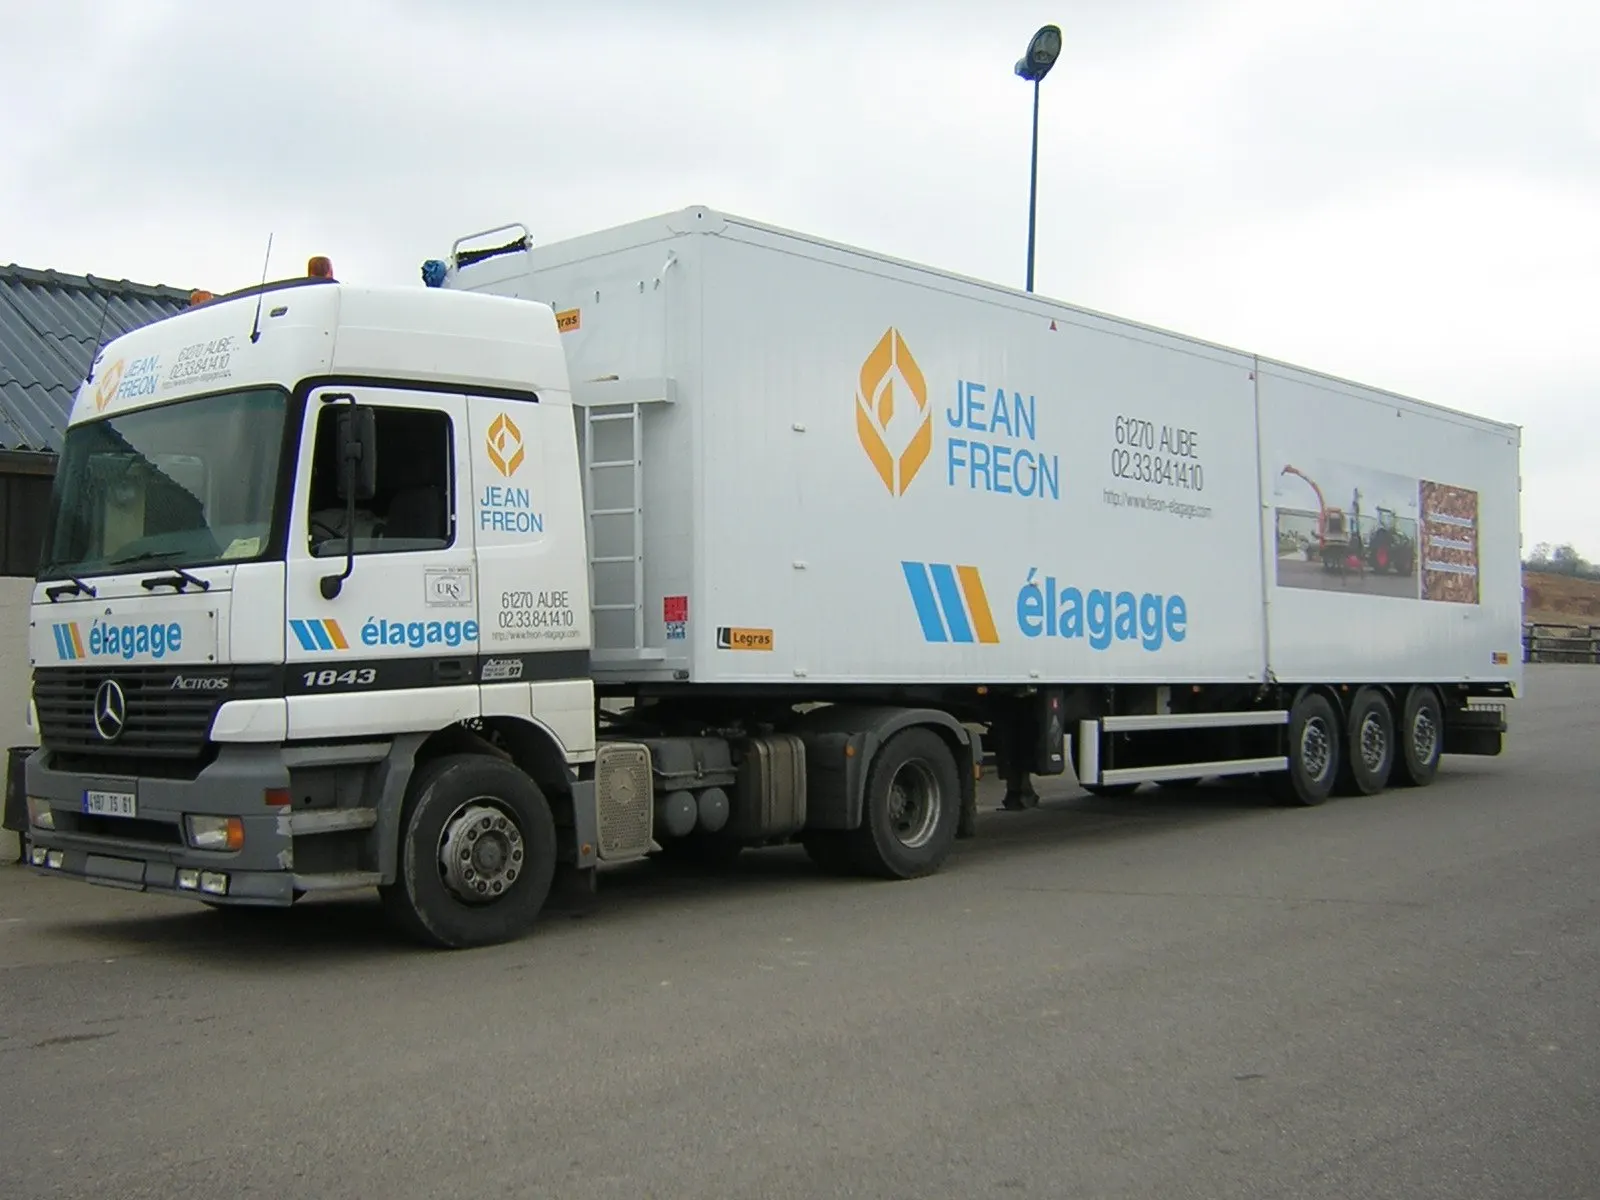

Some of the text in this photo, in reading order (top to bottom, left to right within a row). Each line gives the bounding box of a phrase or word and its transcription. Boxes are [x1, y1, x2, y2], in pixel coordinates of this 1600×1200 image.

[124, 355, 160, 378] JEAN
[116, 374, 160, 400] FREON
[946, 379, 1035, 440] JEAN
[1115, 415, 1198, 459] 61270 AUBE
[948, 437, 1059, 500] FREON
[1111, 448, 1203, 491] 02.33.84.14.10
[480, 486, 529, 508] JEAN
[480, 510, 543, 533] FREON
[501, 591, 569, 609] 61270 AUBE
[1016, 567, 1187, 651] élagage
[498, 609, 574, 628] 02.33.84.14.10
[89, 619, 182, 659] élagage
[361, 616, 479, 648] élagage
[733, 632, 770, 646] Legras
[303, 668, 377, 687] 1843
[508, 667, 521, 676] 97
